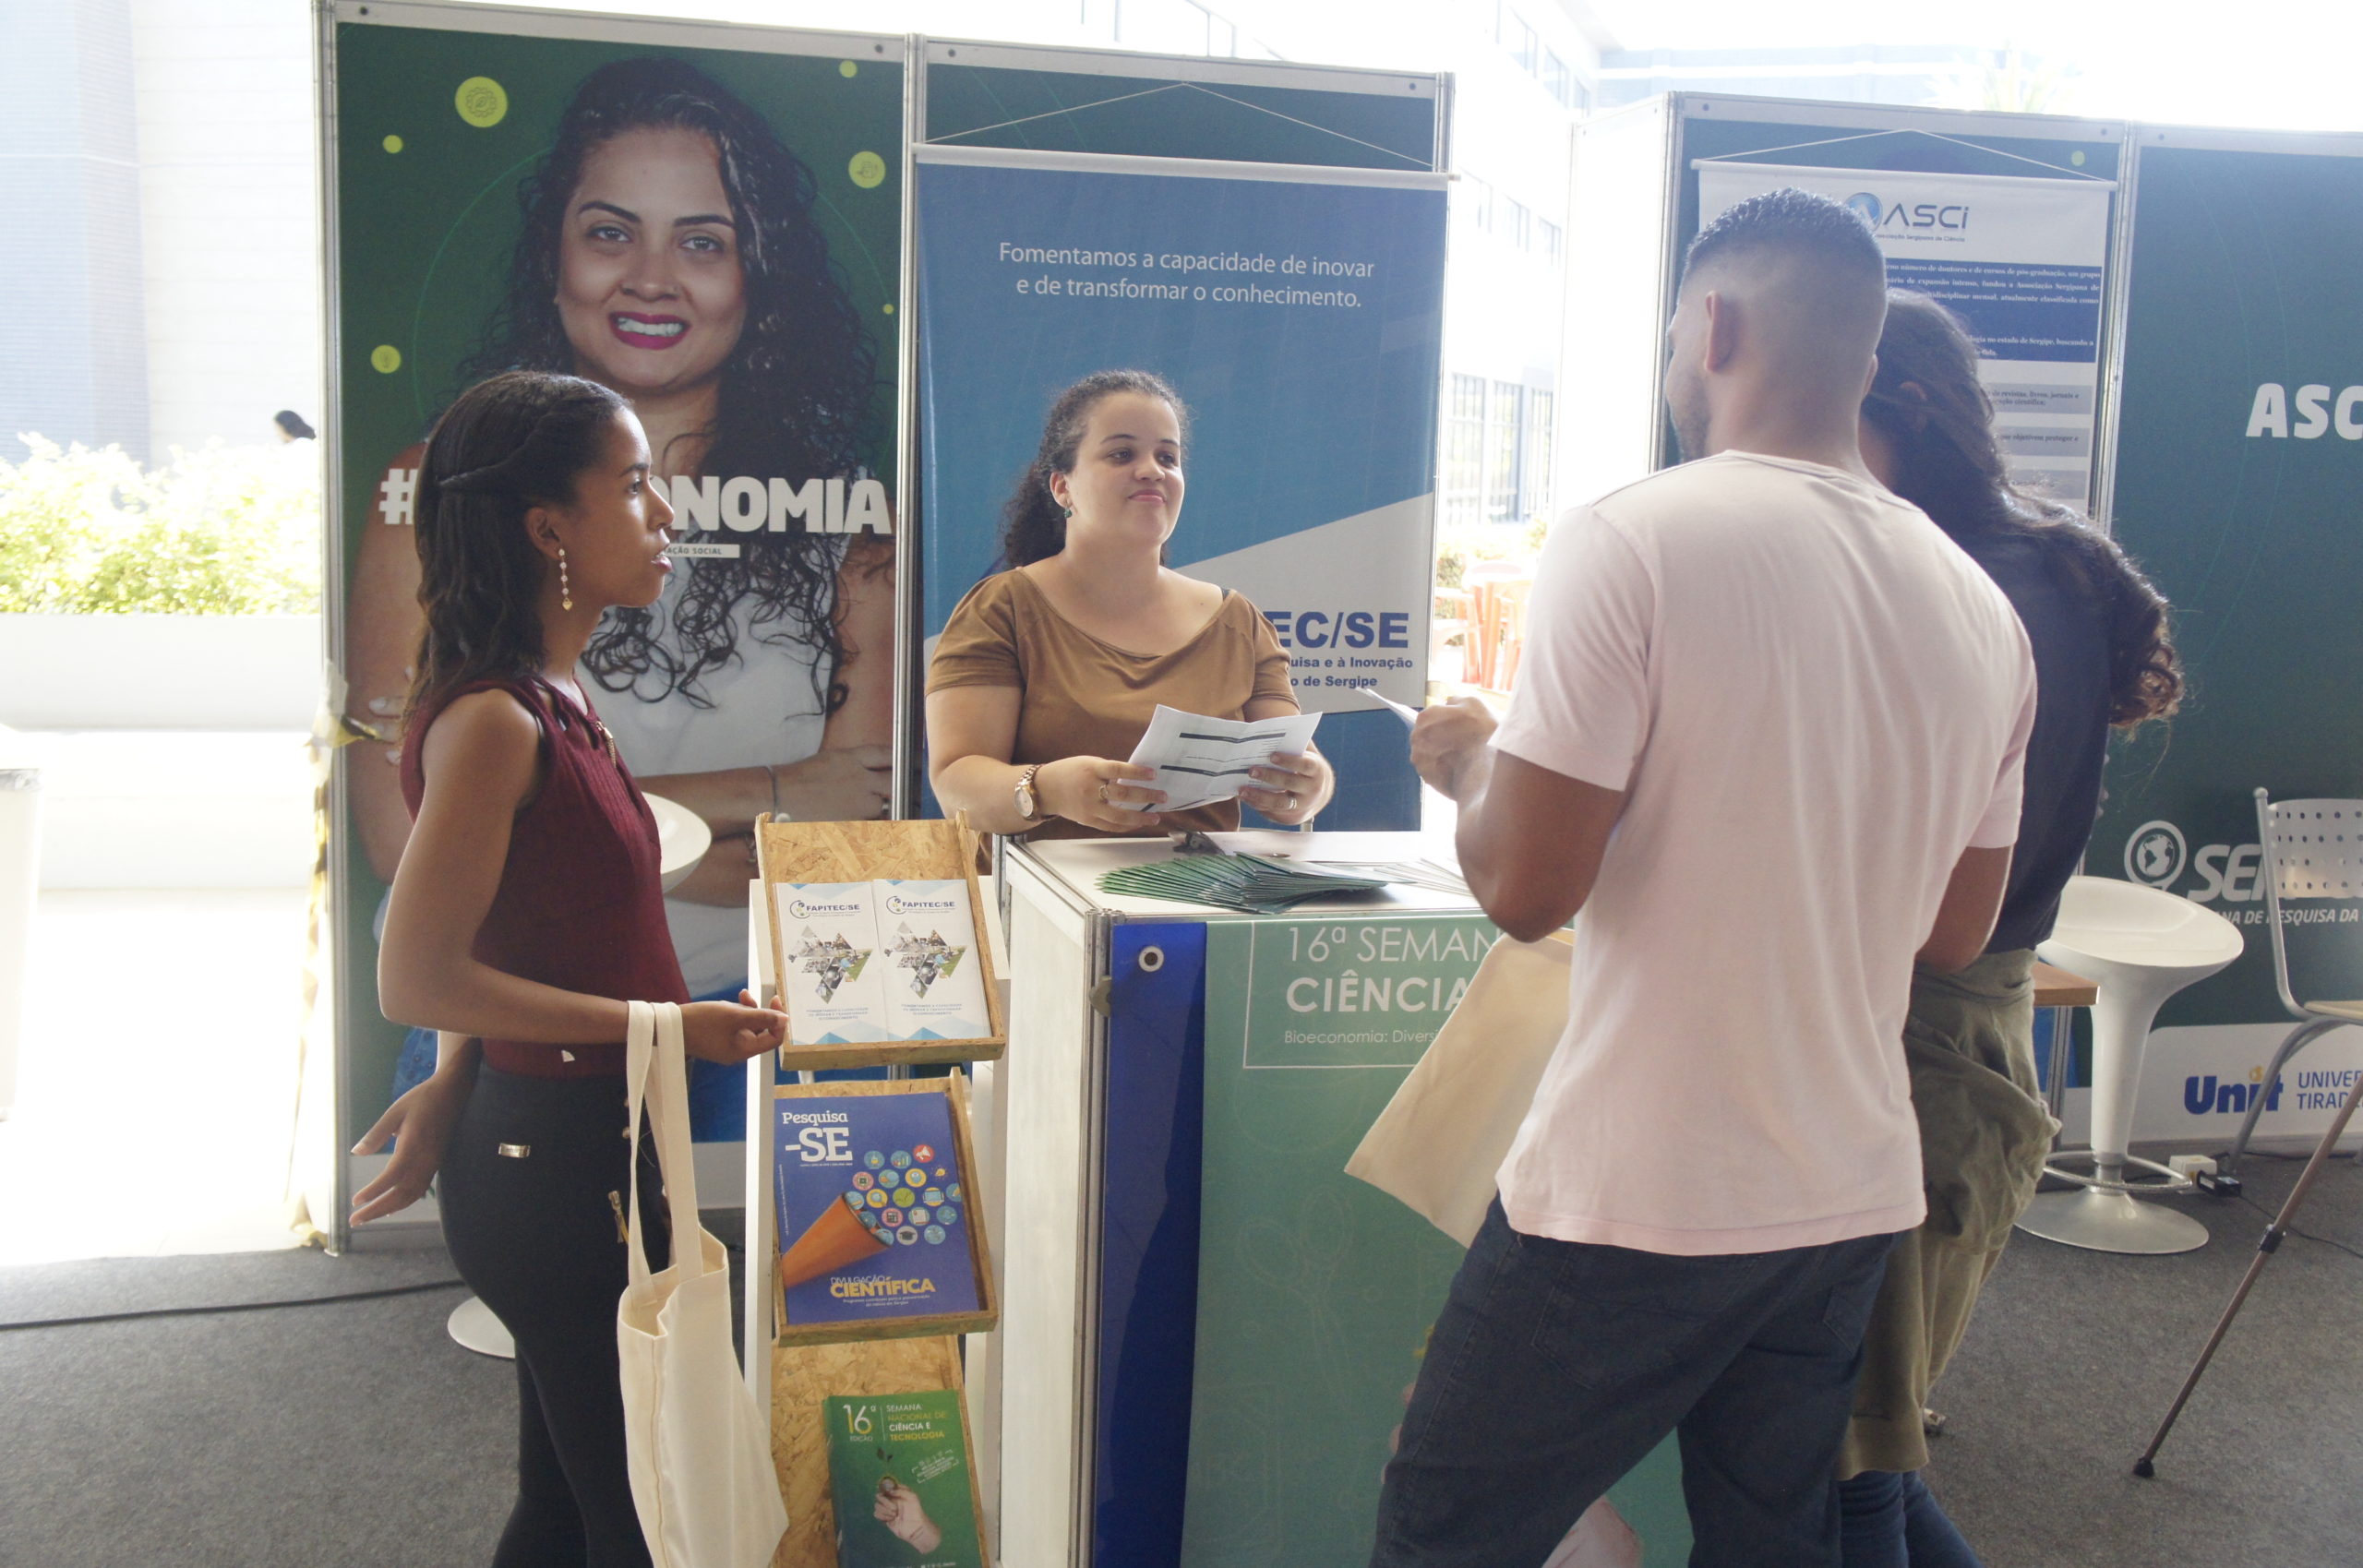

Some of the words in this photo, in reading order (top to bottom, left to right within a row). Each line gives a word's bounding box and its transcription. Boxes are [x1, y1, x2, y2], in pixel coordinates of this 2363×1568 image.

[1000, 242, 1137, 267] Fomentamos
[1143, 253, 1154, 268] a
[1160, 252, 1276, 274] capacidade
[1281, 255, 1307, 274] de
[1313, 257, 1374, 277] inovar
[1016, 279, 1029, 293] e
[1035, 274, 1062, 295] de
[1066, 278, 1188, 300] transformar
[1193, 286, 1206, 301] o
[1212, 283, 1361, 307] conhecimento.
[692, 547, 723, 556] SOCIAL
[1263, 610, 1409, 649] EC/SE
[1325, 658, 1333, 668] e
[1337, 656, 1346, 668] à
[1350, 656, 1413, 670] Inovação
[1303, 676, 1320, 687] de
[1325, 675, 1378, 689] Sergipe
[2244, 910, 2264, 924] DE
[2266, 908, 2338, 927] ESQUISA
[2339, 908, 2359, 923] DA
[1357, 927, 1503, 963] SEMAN
[1286, 969, 1469, 1012] CIÊNCIA
[1284, 1029, 1388, 1045] Bioeconomia:
[782, 1110, 848, 1126] Pesquisa
[830, 1275, 936, 1299] CIENTÍFICA
[886, 1404, 922, 1413] SEMANA
[888, 1412, 931, 1421] NACIONAL
[935, 1410, 946, 1418] DE
[889, 1422, 923, 1432] CIÊNCIA
[890, 1431, 945, 1442] TECNOLOGIA
